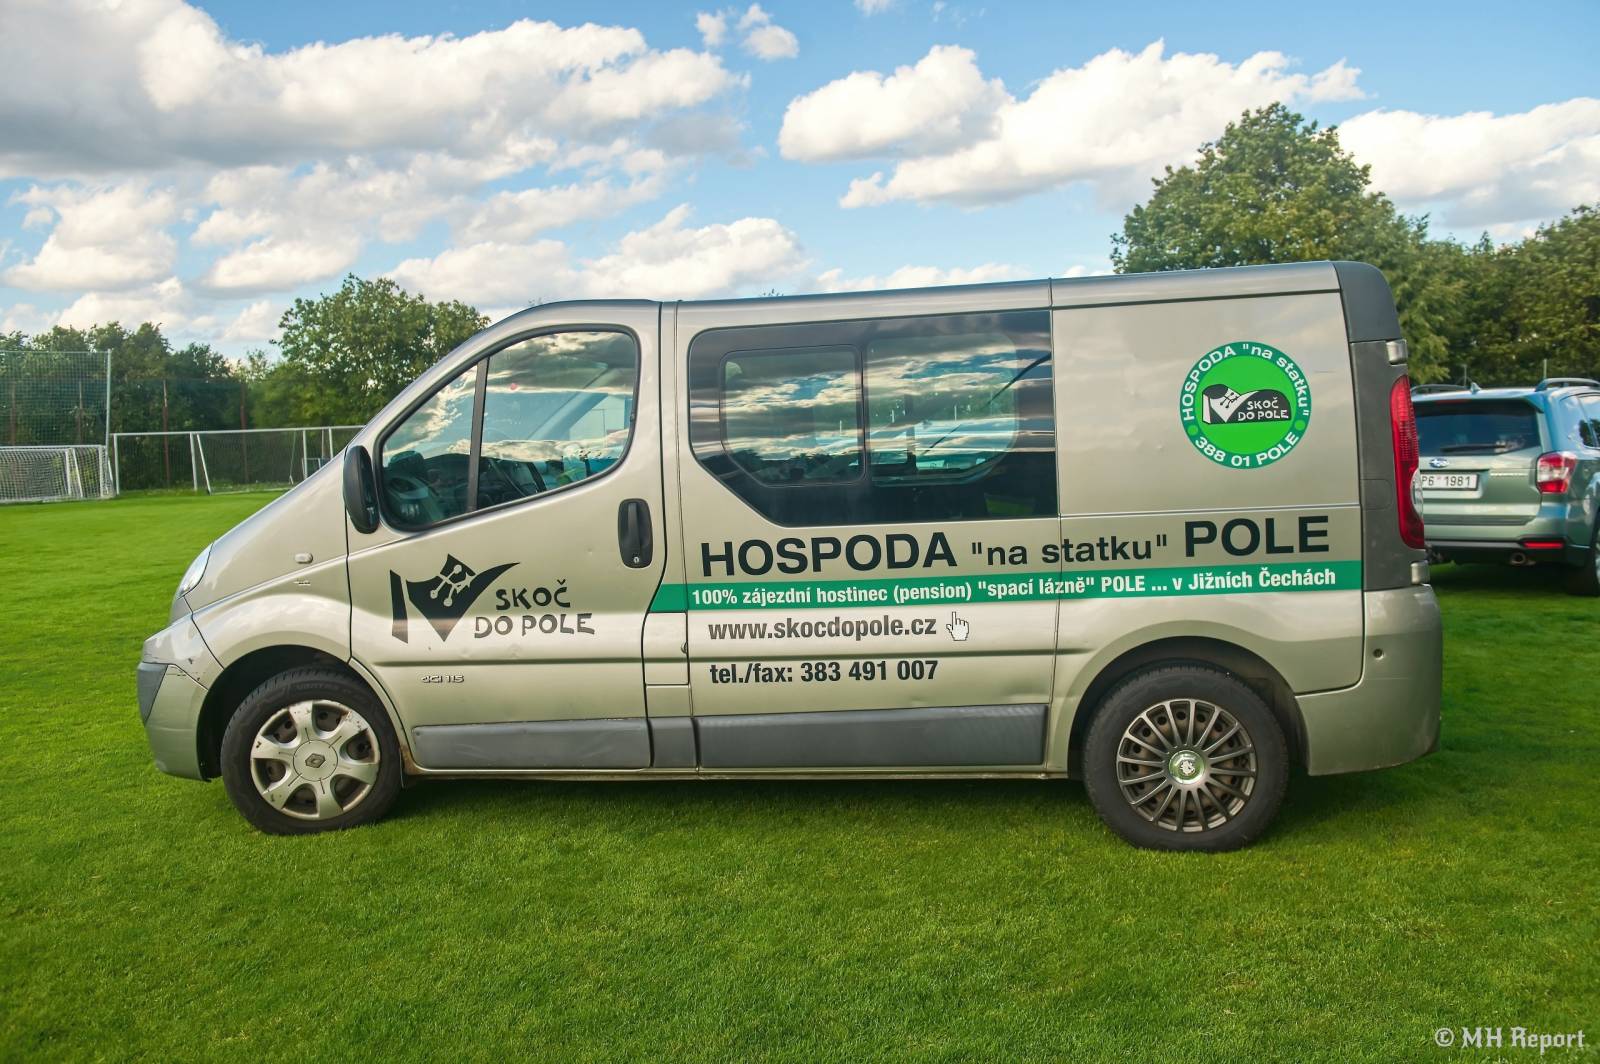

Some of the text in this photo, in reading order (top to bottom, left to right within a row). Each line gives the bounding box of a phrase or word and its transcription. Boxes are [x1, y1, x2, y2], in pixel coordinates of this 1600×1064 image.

[1182, 343, 1310, 421] HOSPODA "na statku"
[1237, 409, 1289, 421] DO POLE
[1246, 397, 1279, 411] SKOČ
[1195, 431, 1300, 467] 388 01 POLE
[1444, 475, 1470, 486] 1981
[700, 515, 1330, 577] HOSPODA "na statku" POLE
[495, 578, 571, 611] SKOČ
[692, 588, 738, 605] 100%
[742, 587, 811, 606] zájezdní
[816, 586, 888, 604] hostinec
[893, 582, 972, 604] (pension)
[978, 578, 1033, 600] "spací
[1039, 578, 1095, 595] lázně"
[1101, 575, 1145, 592] POLE
[1172, 577, 1183, 590] v
[1188, 570, 1252, 590] Jižních
[1258, 566, 1336, 586] Čechách
[474, 612, 595, 639] DO POLE
[708, 614, 937, 641] www.skocdopole.cz
[710, 660, 939, 684] tel./fax: 383 491 007
